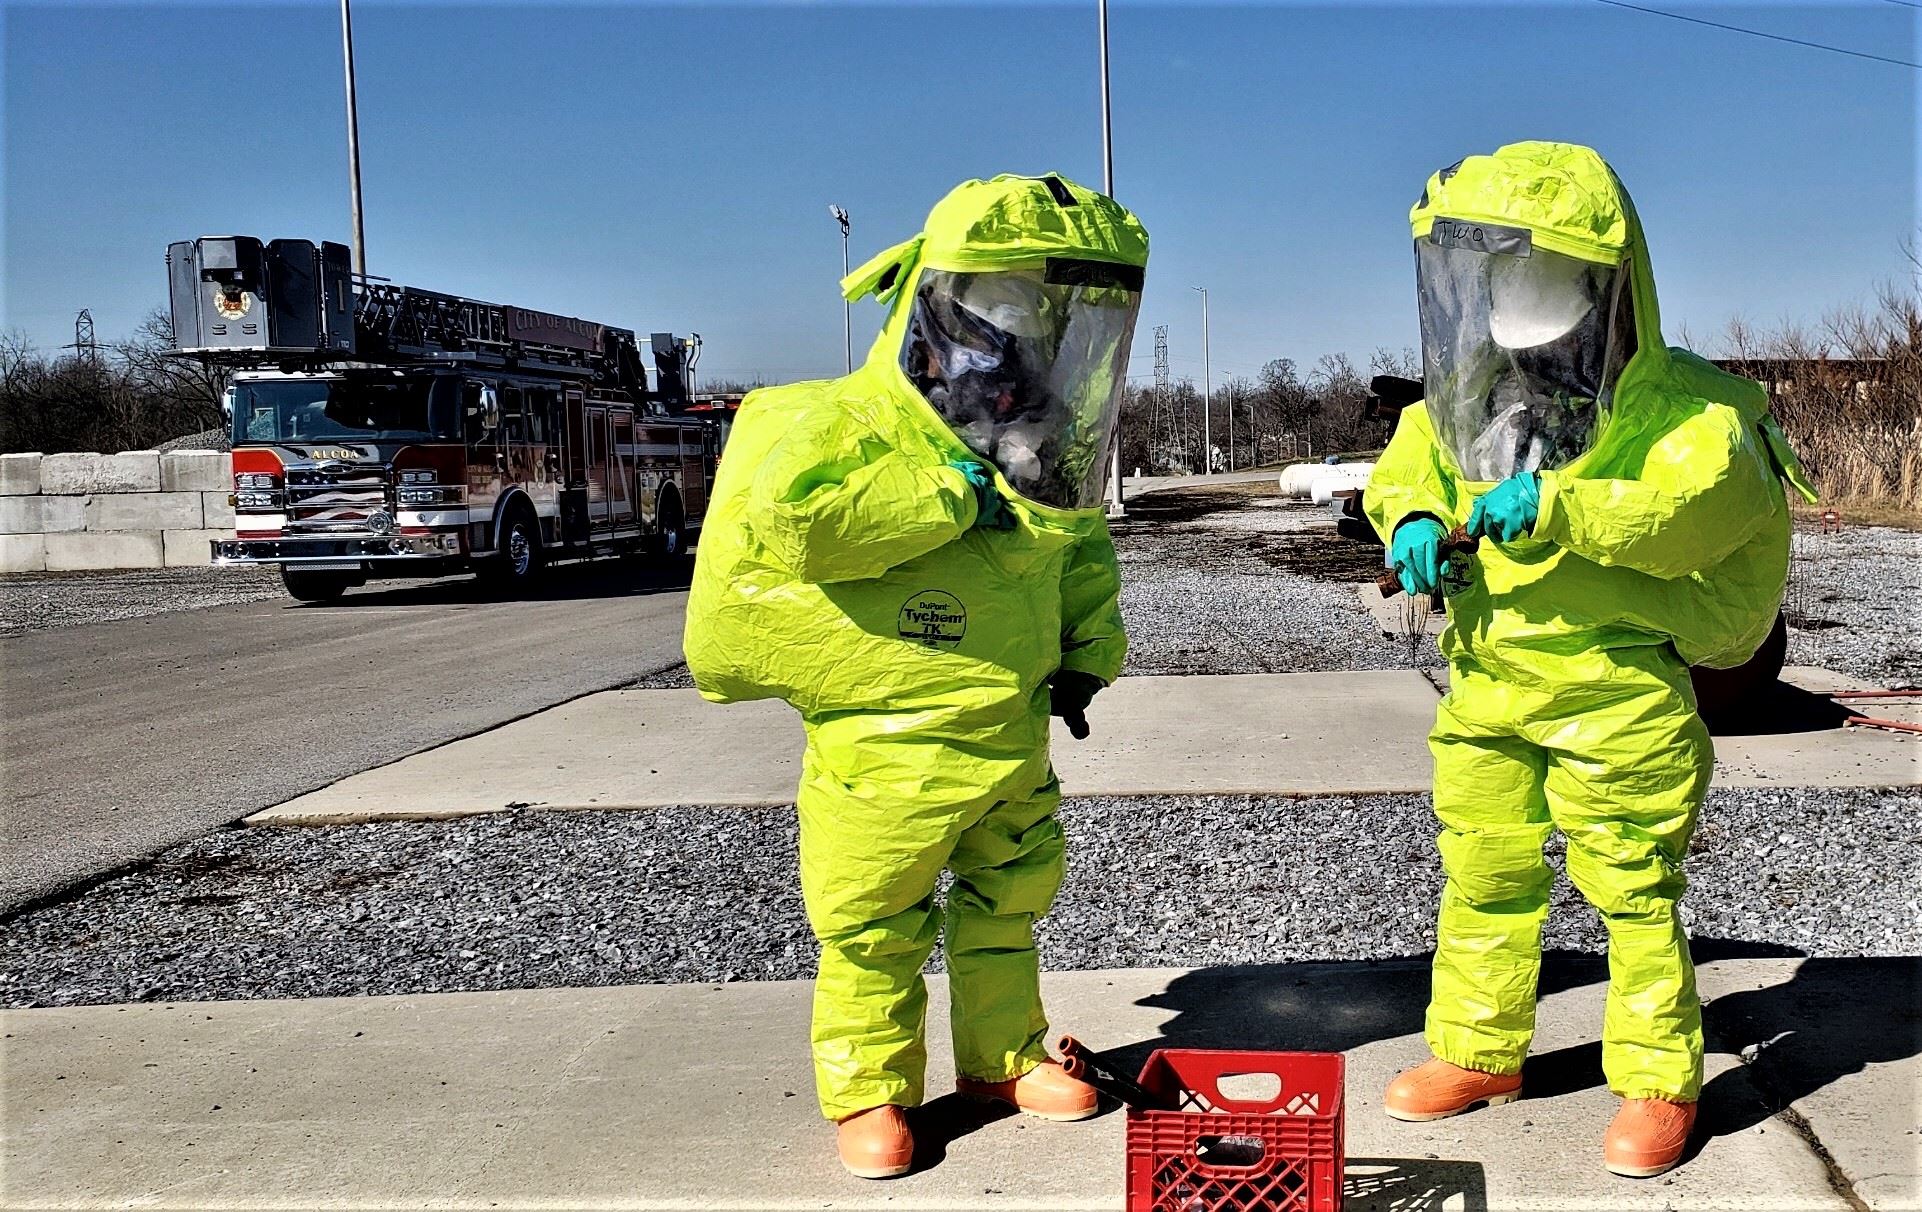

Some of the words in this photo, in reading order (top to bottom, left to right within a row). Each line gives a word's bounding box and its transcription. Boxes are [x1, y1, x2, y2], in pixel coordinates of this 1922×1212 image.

[1437, 221, 1484, 242] TWO
[515, 310, 541, 331] CITY
[546, 316, 560, 328] OF
[312, 450, 359, 459] ALCOA
[904, 608, 962, 623] Tychem
[922, 623, 941, 634] TK
